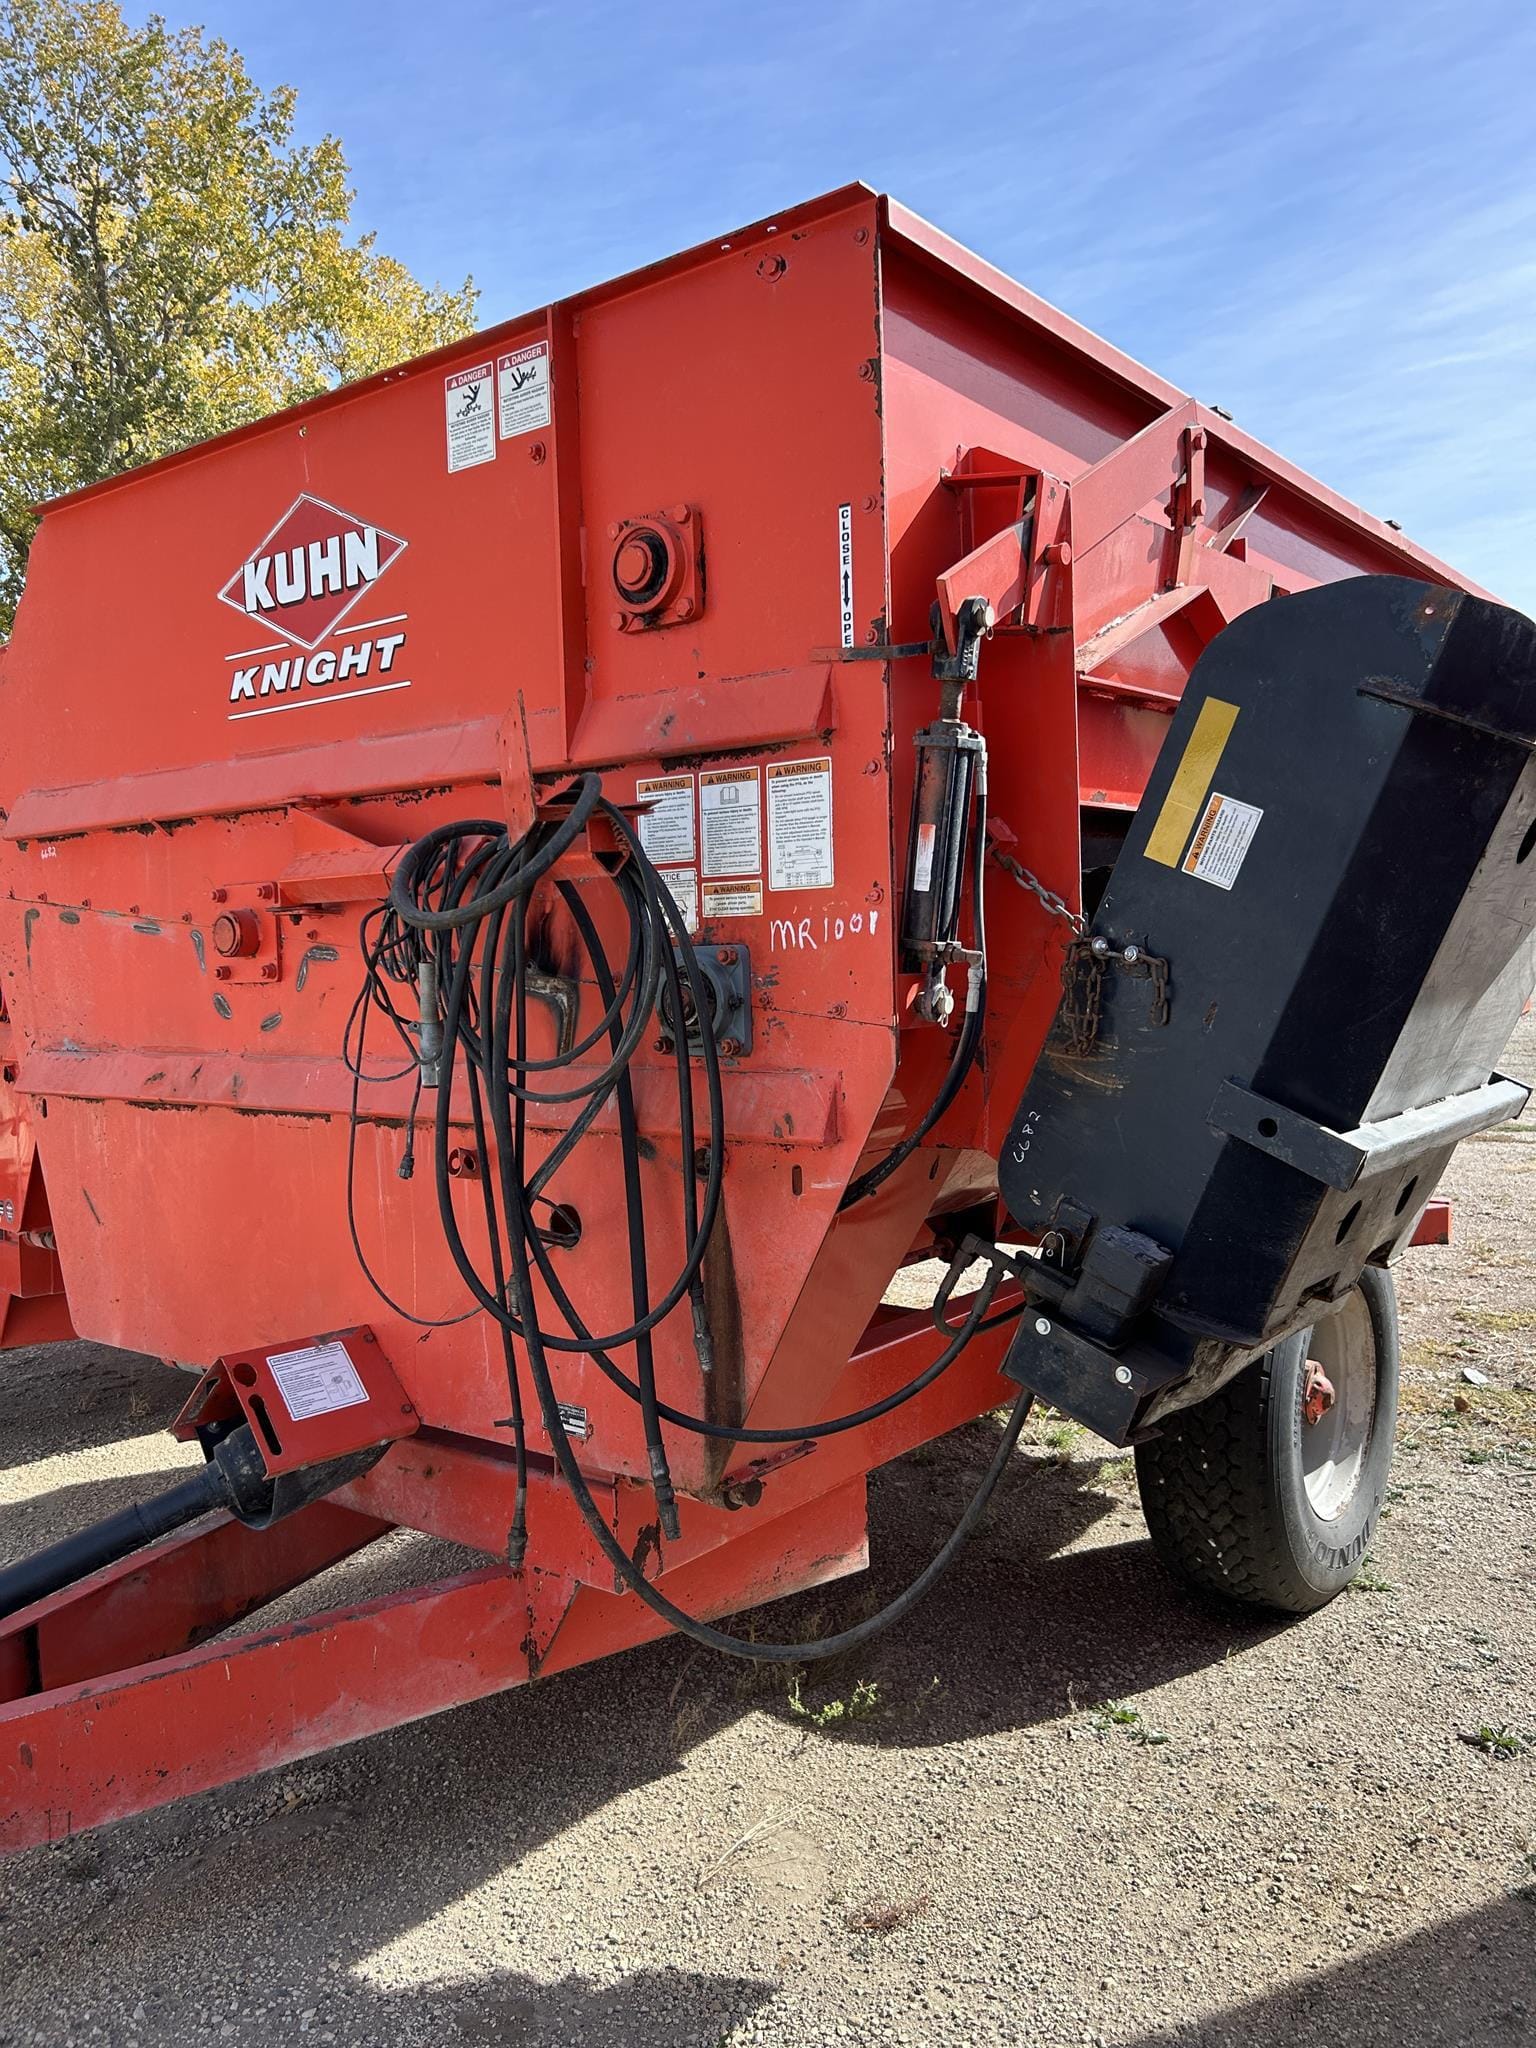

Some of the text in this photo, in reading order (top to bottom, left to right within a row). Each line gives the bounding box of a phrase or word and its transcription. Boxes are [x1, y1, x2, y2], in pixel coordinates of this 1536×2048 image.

[511, 347, 542, 366] DANGER
[458, 368, 488, 386] DANGER
[841, 508, 850, 565] CLOSE
[243, 527, 379, 614] KUHN
[843, 611, 852, 648] OPE
[229, 633, 406, 703] KNIGHT
[783, 762, 822, 775] WARNING
[651, 779, 685, 790] WARNING
[716, 772, 751, 784] WARNING
[1197, 809, 1218, 851] WARNING
[659, 873, 681, 882] OTICE
[719, 884, 750, 893] WARNING
